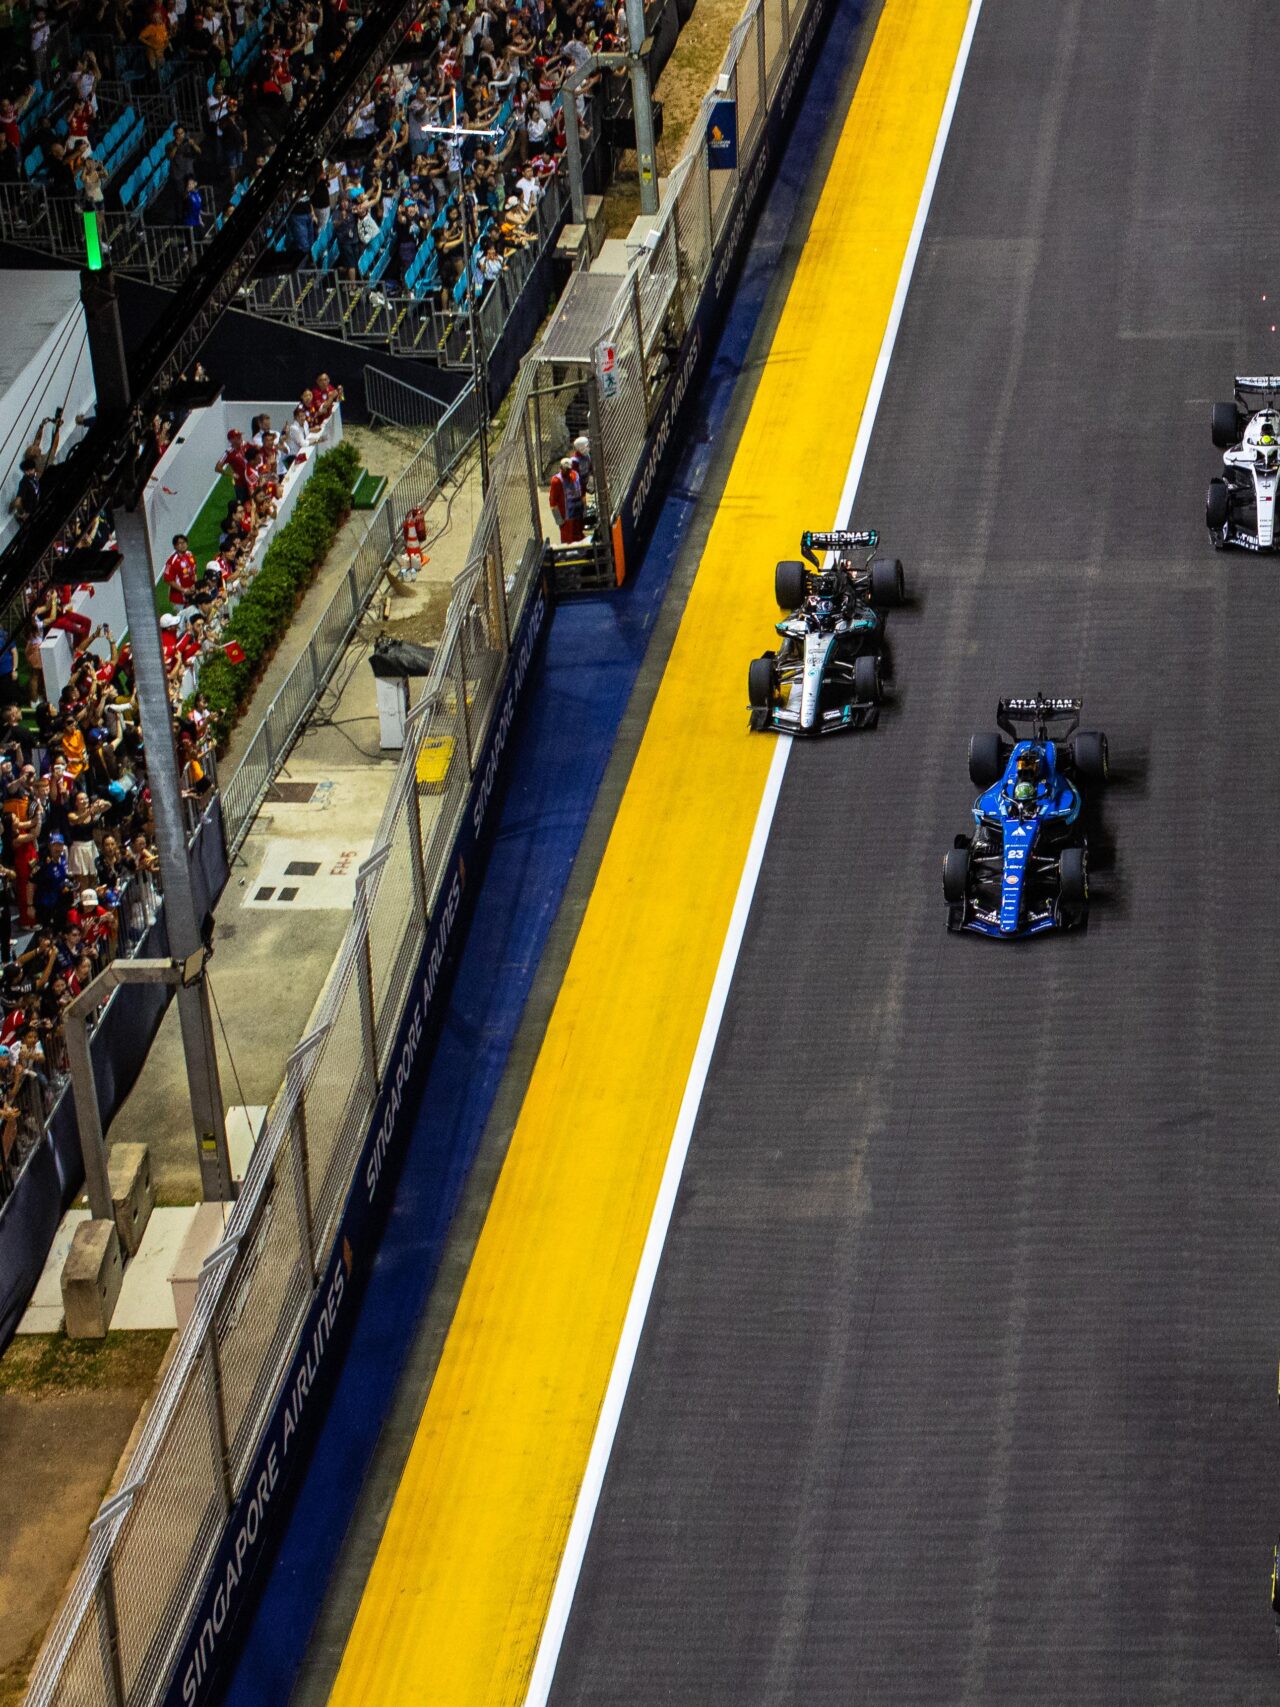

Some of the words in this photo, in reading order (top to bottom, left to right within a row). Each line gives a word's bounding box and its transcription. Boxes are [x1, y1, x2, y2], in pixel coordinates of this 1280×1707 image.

[632, 410, 671, 528] SINGAPORE
[670, 338, 698, 425] AIRLINES
[812, 531, 870, 542] PETRONAS
[473, 694, 515, 839] SINGAPORE
[513, 588, 545, 702] AIRLINES
[1007, 849, 1024, 859] 23
[366, 1003, 423, 1202] SINGAPORE
[424, 871, 461, 1008] AIRLINES
[182, 1447, 280, 1707] SINGAPORE
[283, 1260, 345, 1457] AIRLINES
